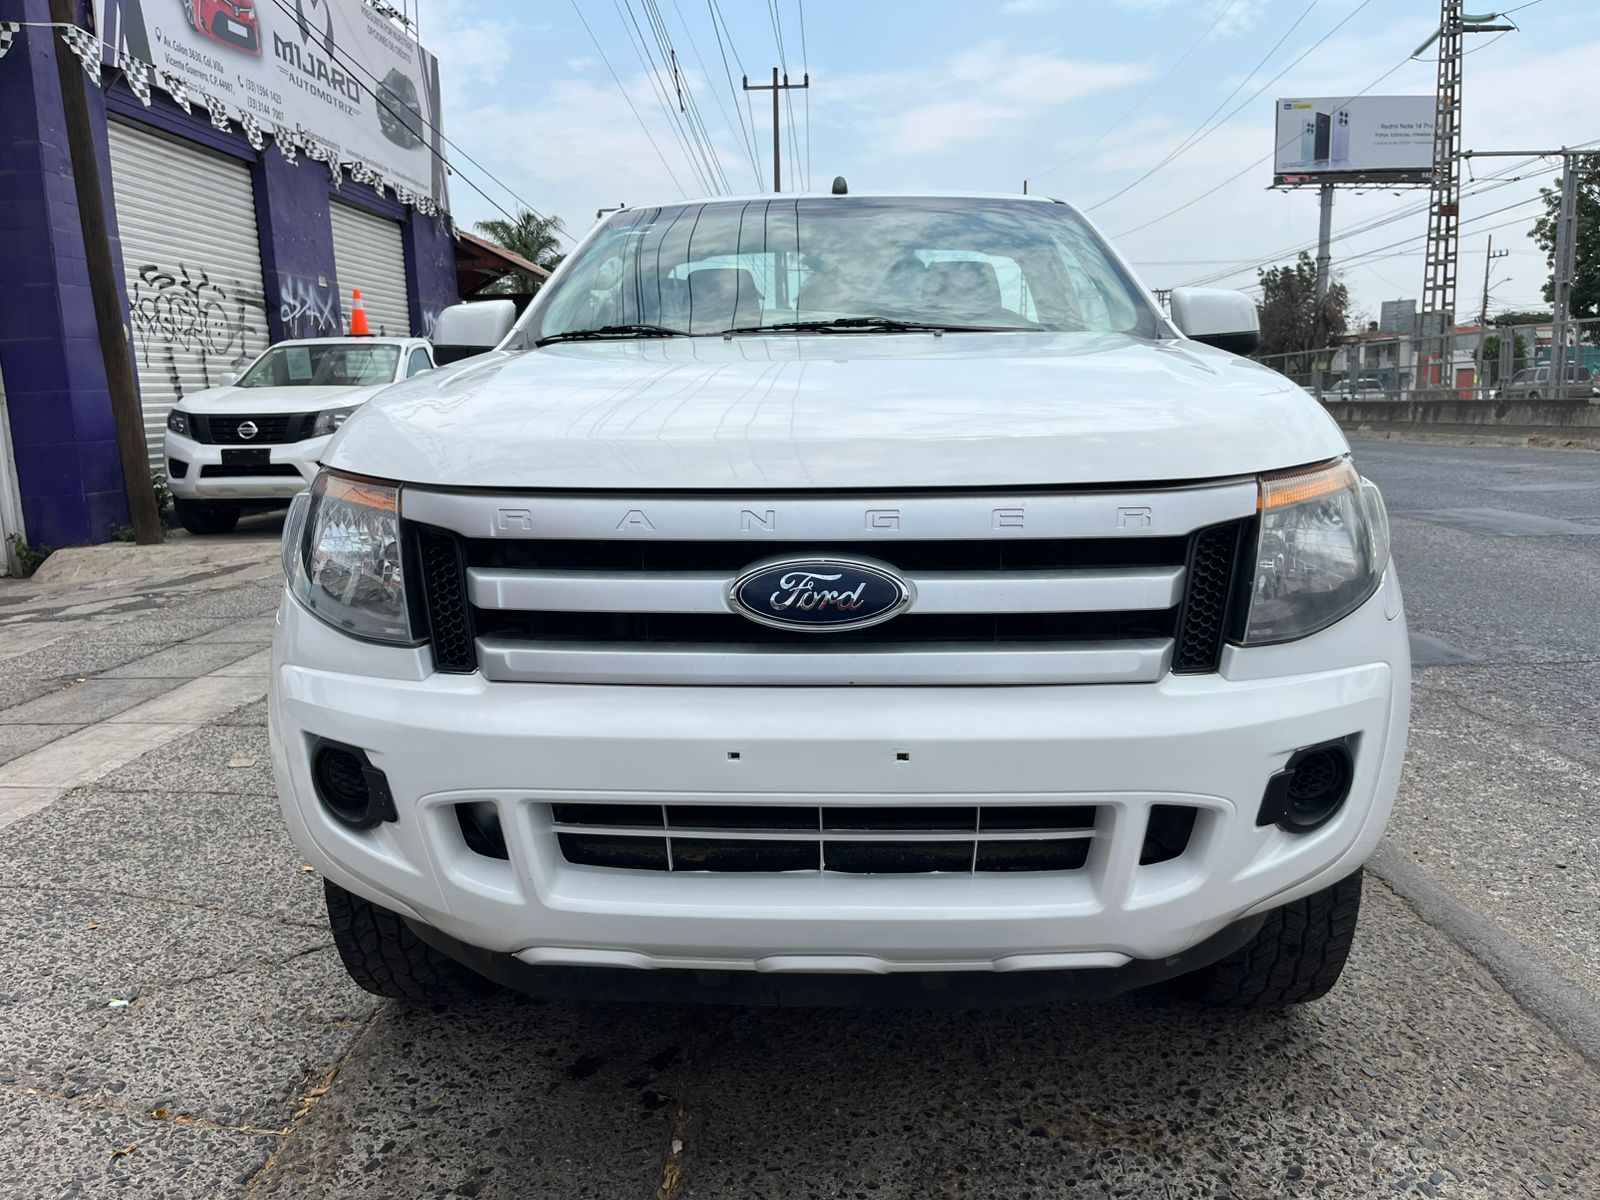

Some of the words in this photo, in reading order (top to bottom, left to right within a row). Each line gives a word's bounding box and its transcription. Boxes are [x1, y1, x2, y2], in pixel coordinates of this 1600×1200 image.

[164, 36, 172, 48] Av.
[273, 30, 360, 104] MIJARO
[288, 73, 353, 116] AUTOMOTRIZ
[498, 506, 1152, 532] RANGER
[770, 571, 866, 611] Ford
